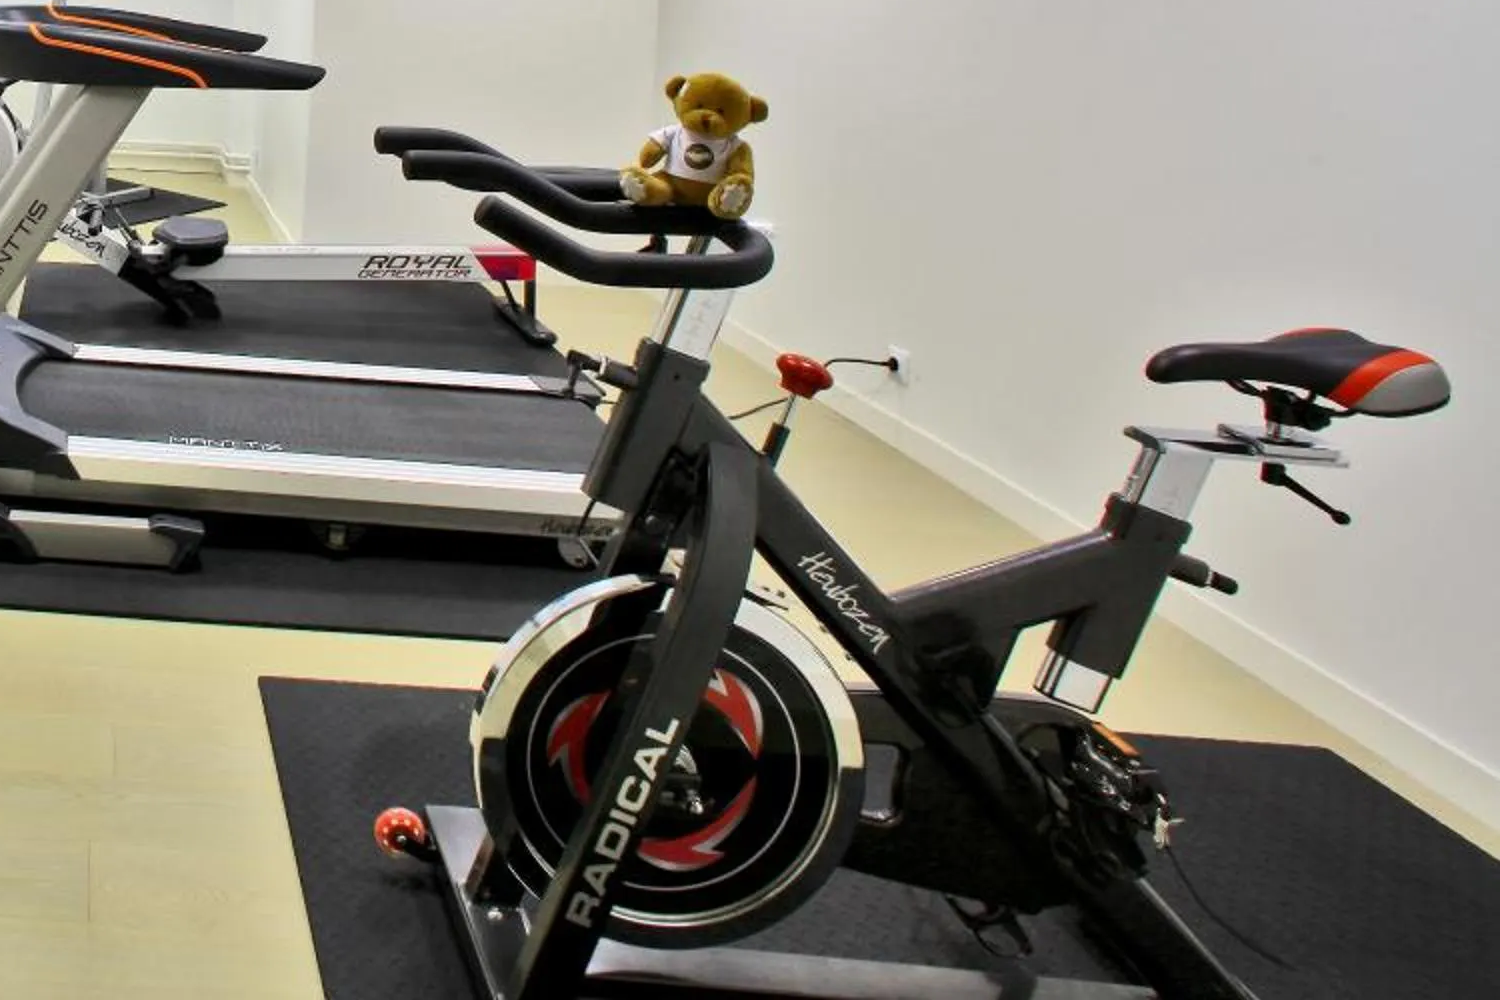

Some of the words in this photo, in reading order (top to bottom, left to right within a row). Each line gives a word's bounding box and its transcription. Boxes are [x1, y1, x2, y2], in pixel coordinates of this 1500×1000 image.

[364, 255, 472, 269] ROYAL
[357, 269, 472, 279] GENERATOR
[565, 718, 680, 928] RADICAL
